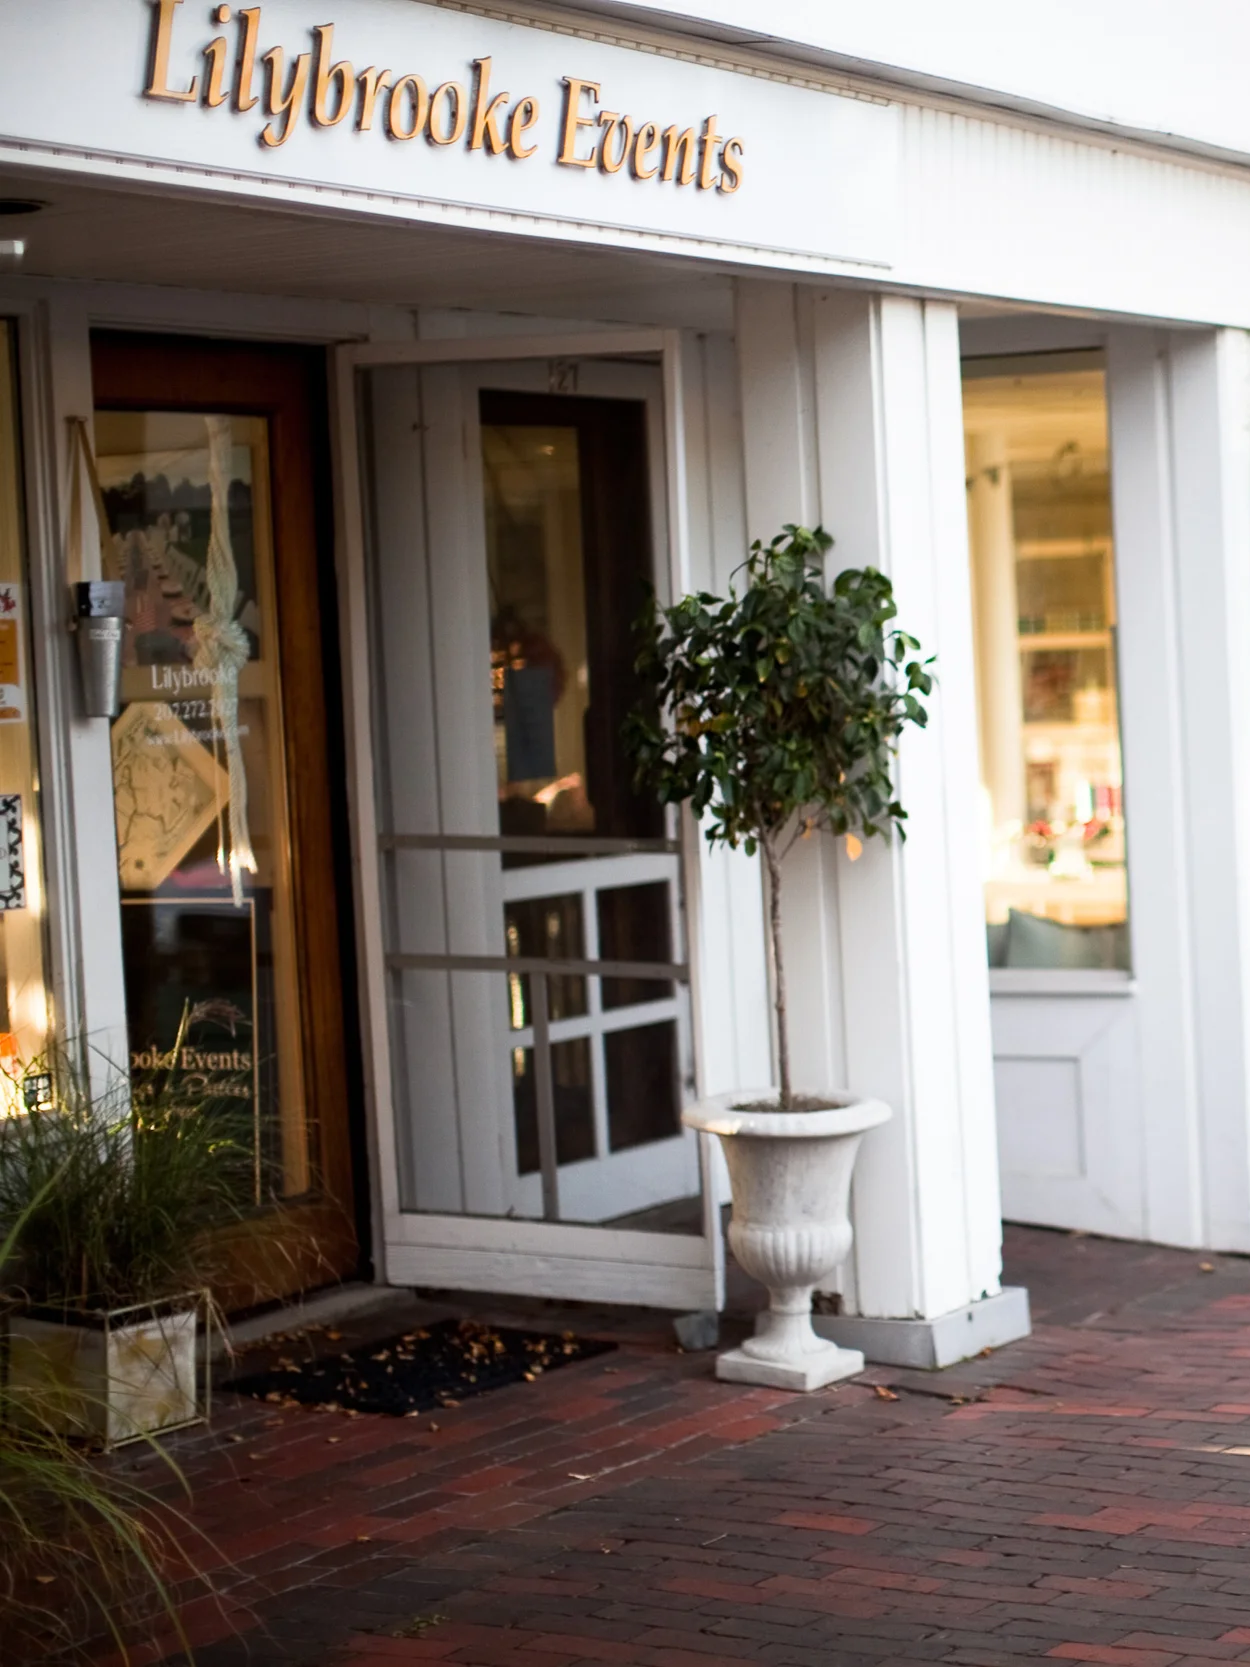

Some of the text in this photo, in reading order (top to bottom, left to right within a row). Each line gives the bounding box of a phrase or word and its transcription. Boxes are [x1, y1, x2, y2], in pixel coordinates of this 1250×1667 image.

[144, 0, 745, 195] Lilybrooke Events
[181, 1047, 251, 1070] Events
